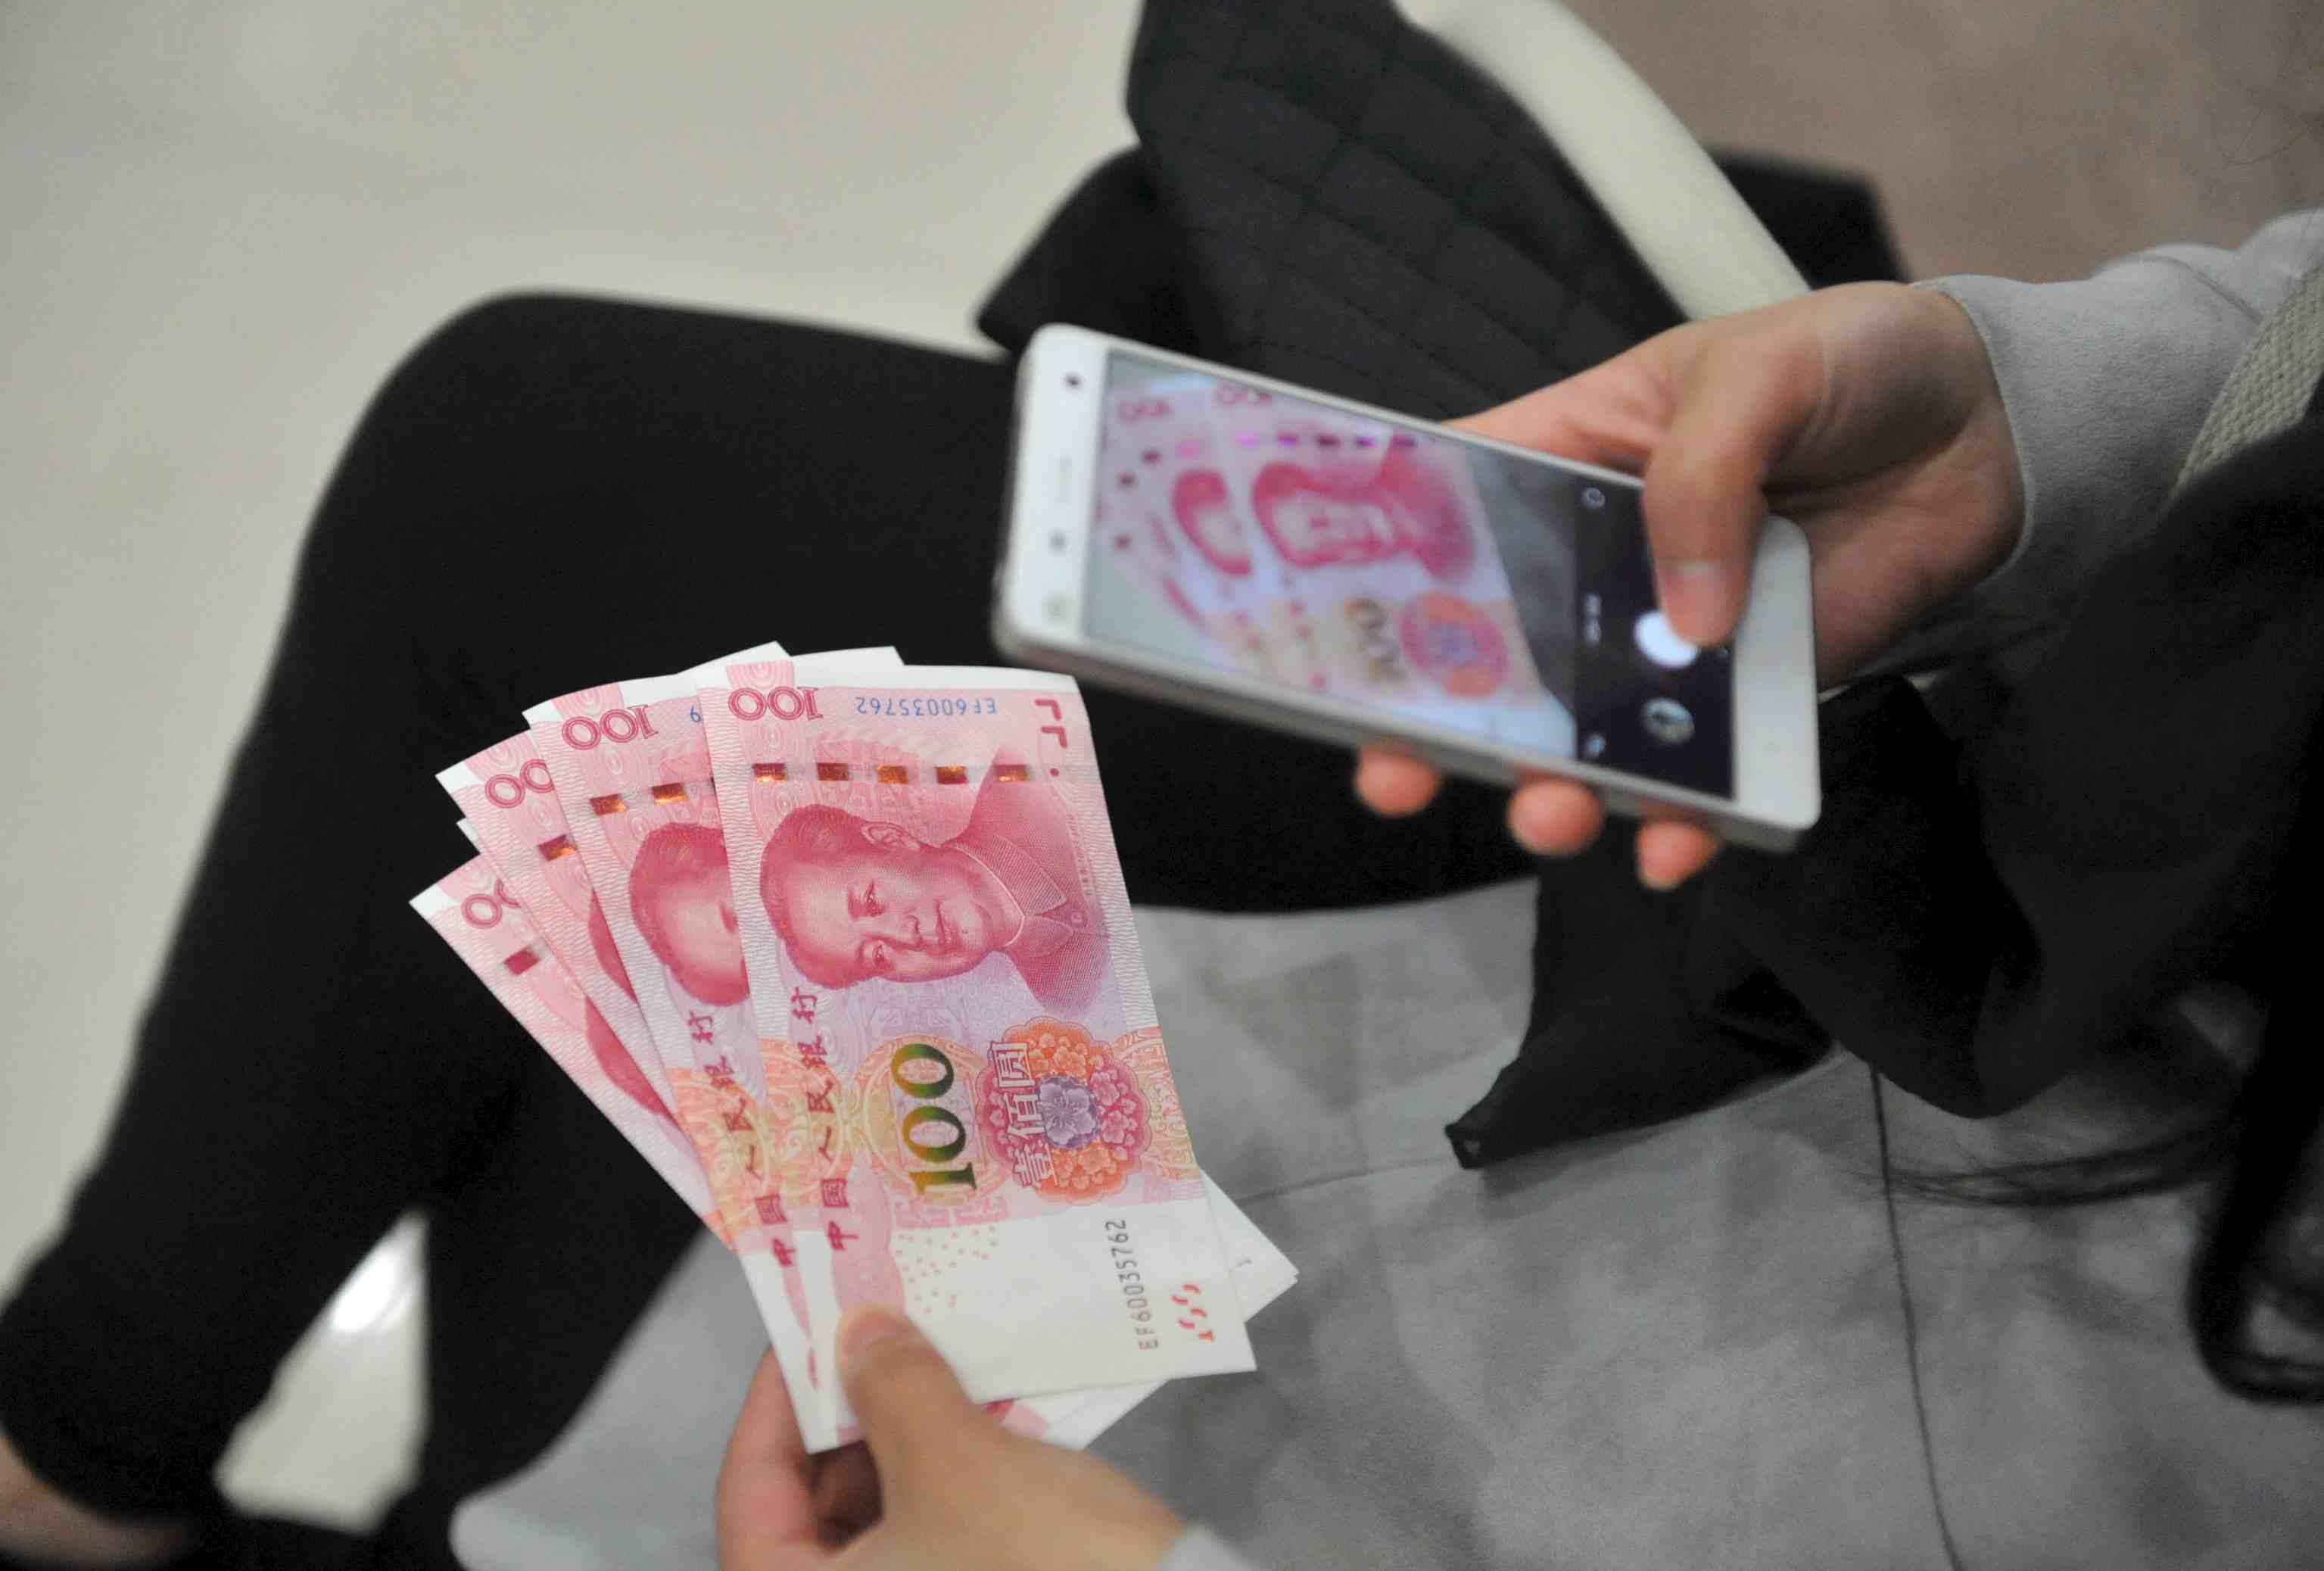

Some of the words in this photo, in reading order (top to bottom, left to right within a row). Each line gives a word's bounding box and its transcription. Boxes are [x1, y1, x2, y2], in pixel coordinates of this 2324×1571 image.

[562, 705, 659, 750] 100
[728, 687, 824, 721] 100
[855, 696, 997, 716] EF60035762
[791, 987, 859, 1251] 中国人民银行
[892, 1042, 977, 1195] 100
[1105, 1218, 1159, 1351] EF60035762
